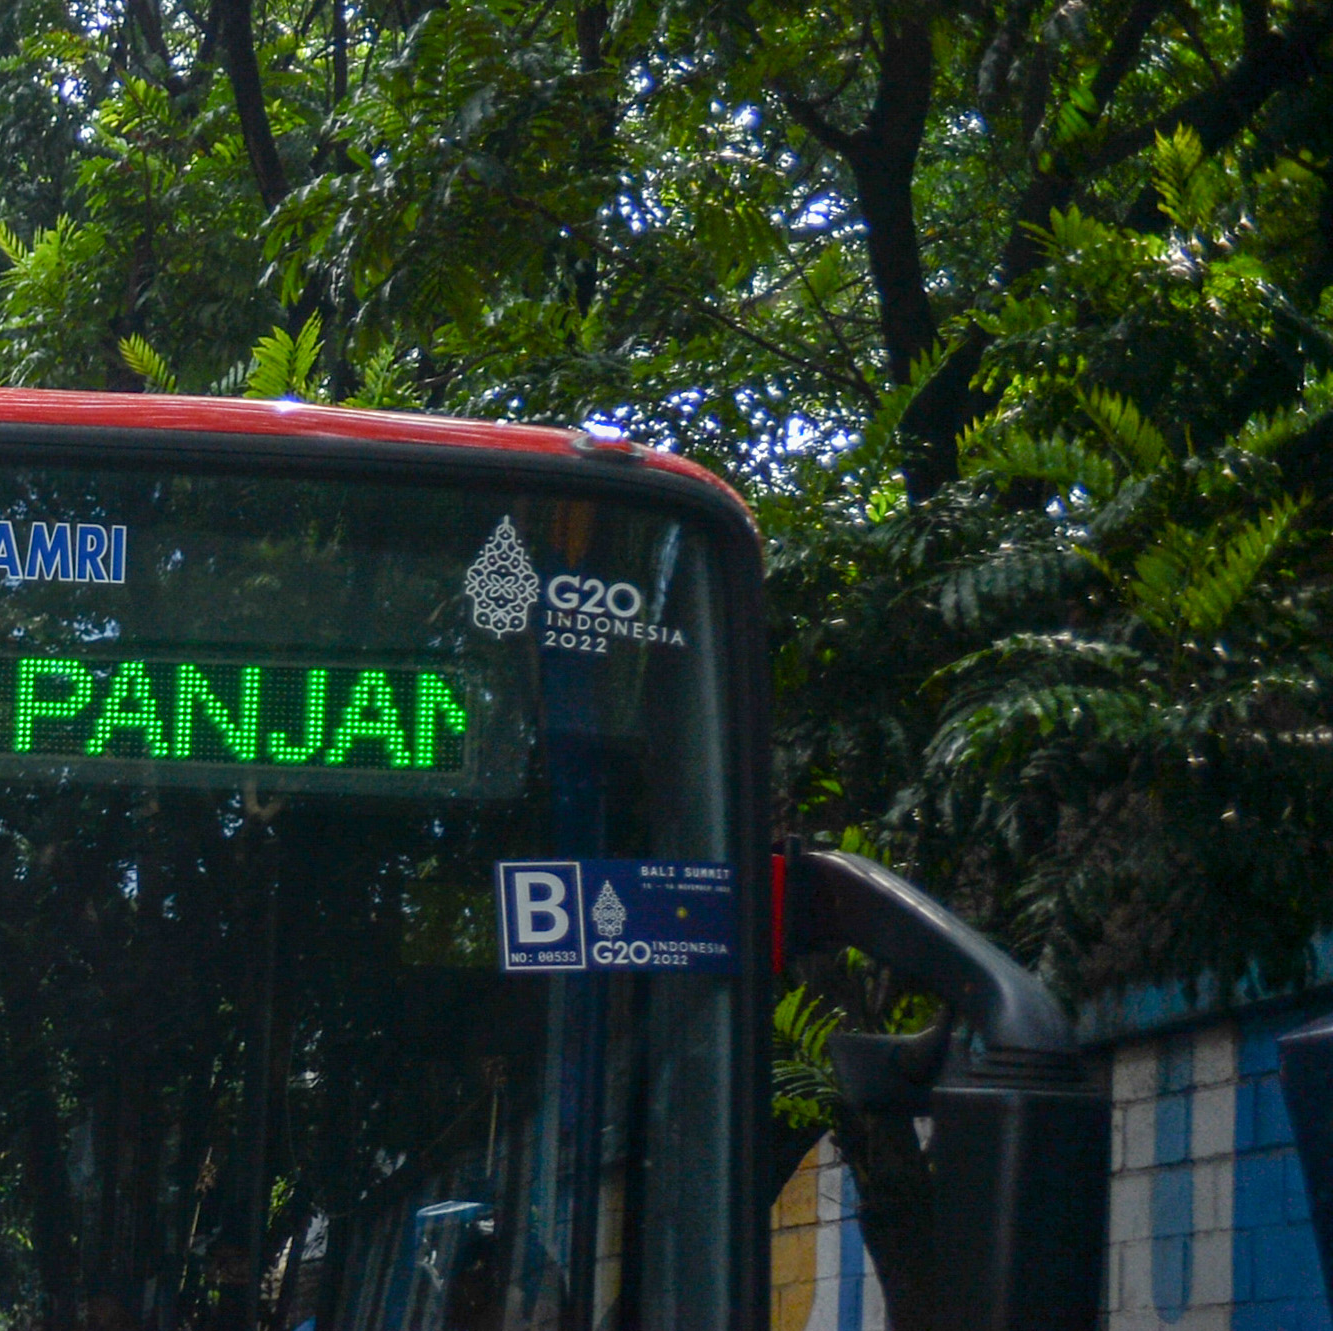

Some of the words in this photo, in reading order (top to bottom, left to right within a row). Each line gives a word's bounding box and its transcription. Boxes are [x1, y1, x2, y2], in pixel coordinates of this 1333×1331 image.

[548, 575, 641, 617] G20
[546, 610, 685, 646] INDONESIA
[544, 631, 607, 653] 2022
[641, 866, 675, 877] BALI
[685, 867, 730, 879] SUMMIT
[514, 871, 569, 943] B
[511, 953, 533, 963] NO:
[538, 951, 576, 963] 00533
[593, 941, 651, 964] G20
[653, 941, 728, 954] INDONESIA
[653, 955, 688, 965] 2022
